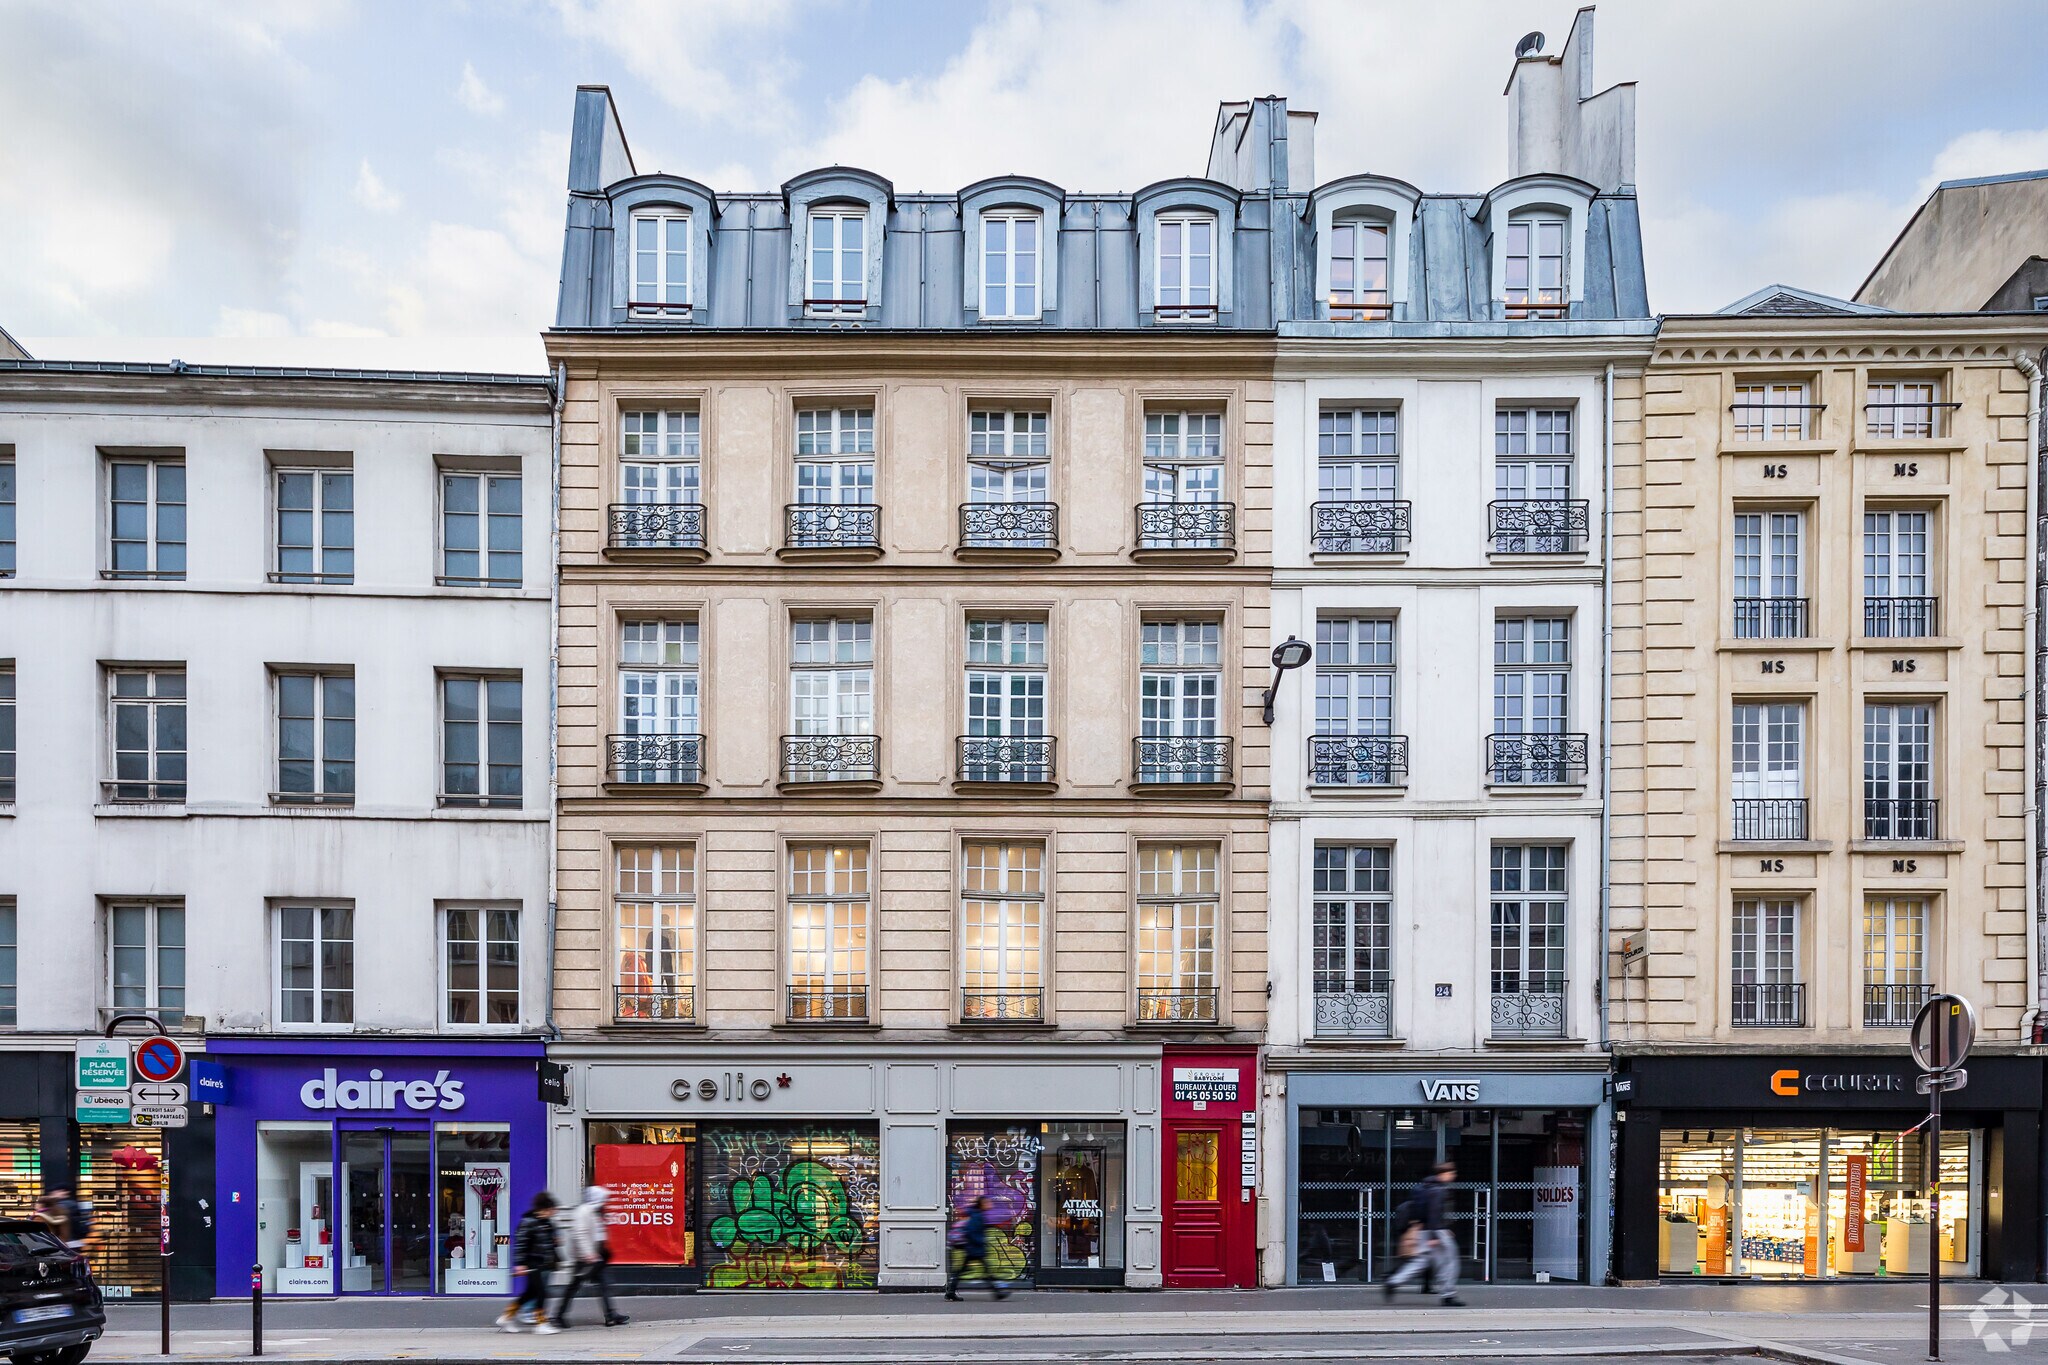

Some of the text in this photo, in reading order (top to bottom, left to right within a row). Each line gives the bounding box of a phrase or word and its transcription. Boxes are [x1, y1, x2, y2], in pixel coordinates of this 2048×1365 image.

[1763, 465, 1788, 479] MS
[1893, 463, 1918, 477] MS
[1761, 660, 1785, 674] MS
[1892, 659, 1916, 673] MS
[1760, 859, 1784, 873] MS
[1892, 859, 1917, 873] MS
[1436, 986, 1450, 996] 24
[89, 1061, 117, 1069] PLACE
[81, 1067, 125, 1076] RÉSERVÉE
[199, 1077, 224, 1089] claire's
[1175, 1083, 1207, 1091] BUREAUX
[1208, 1082, 1213, 1090] À
[300, 1068, 466, 1111] claire's
[1175, 1091, 1237, 1100] 01 45 05 50 50
[1537, 1186, 1574, 1203] SOLDES
[1062, 1199, 1099, 1209] ATTACK
[288, 1278, 329, 1286] claires.com
[457, 1278, 498, 1287] claires.com
